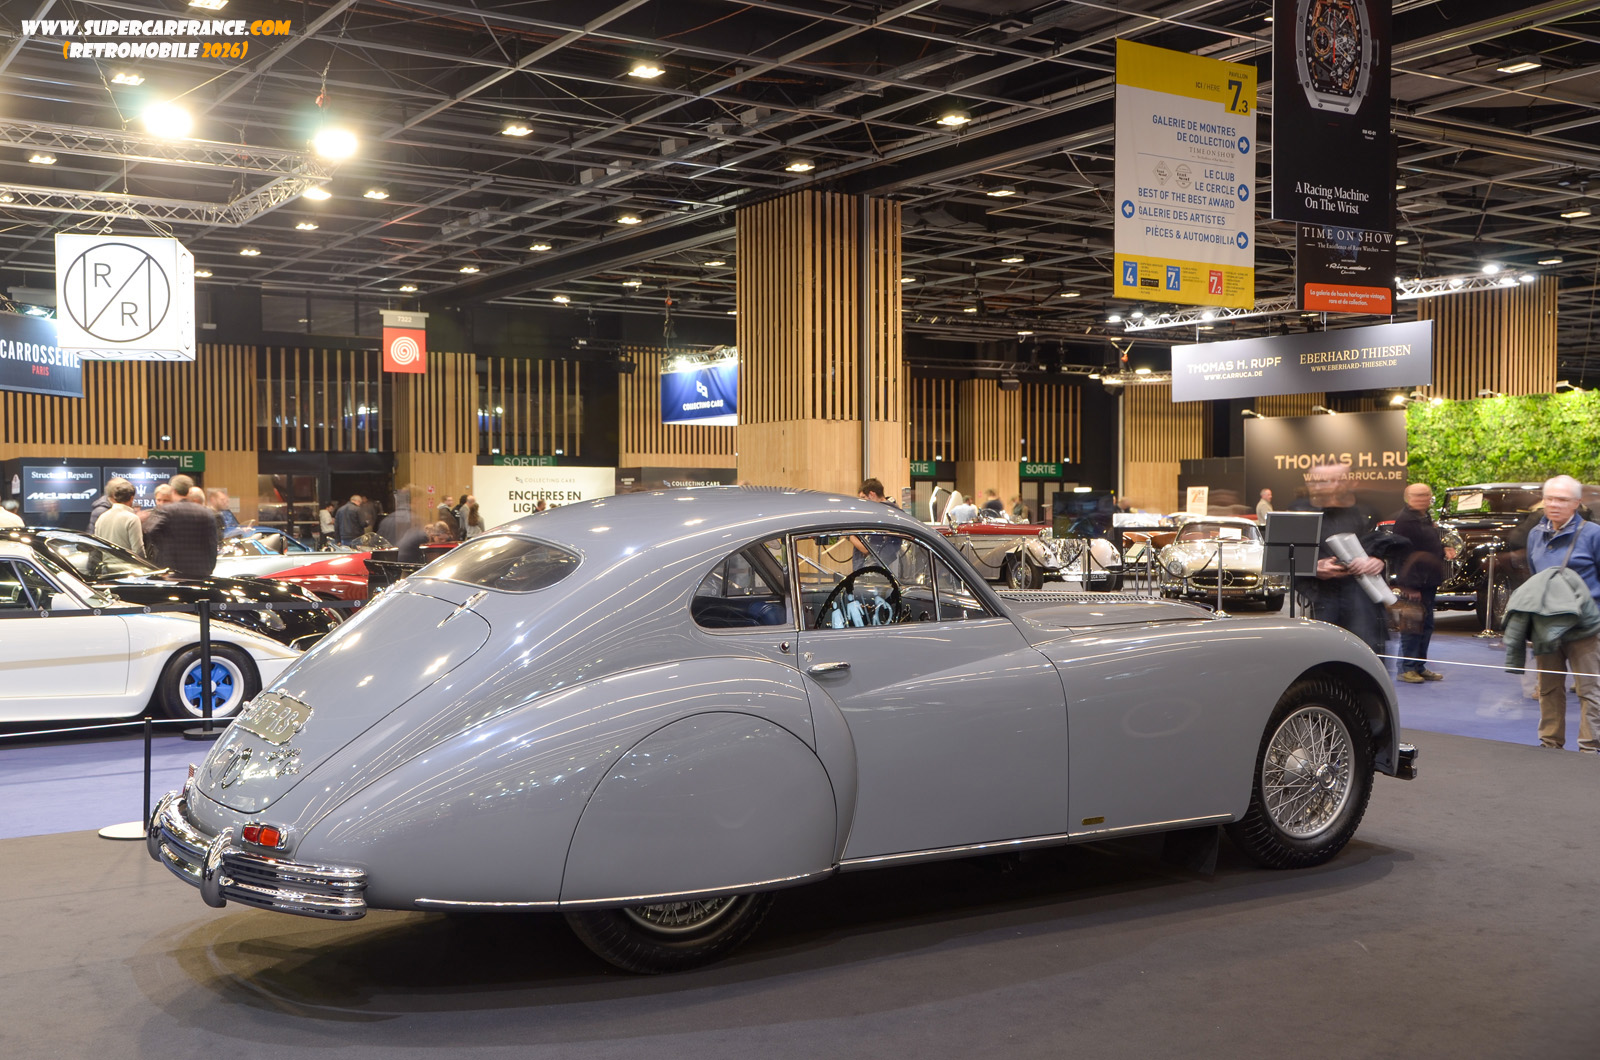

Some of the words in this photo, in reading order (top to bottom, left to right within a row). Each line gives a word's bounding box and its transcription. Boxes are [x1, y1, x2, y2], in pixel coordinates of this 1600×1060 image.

[1229, 71, 1248, 79] PAVILLON
[1206, 83, 1220, 92] HERE
[1228, 79, 1249, 113] 7.3
[1152, 115, 1185, 129] GALERIE
[1187, 120, 1198, 131] DE
[1200, 123, 1236, 137] MONTRES
[1177, 132, 1187, 142] DE
[1189, 133, 1236, 149] COLLECTION
[1204, 169, 1214, 179] LE
[1215, 170, 1235, 181] CLUB
[1195, 181, 1204, 191] LE
[1206, 183, 1235, 196] CERCLE
[1295, 181, 1302, 194] A
[1304, 182, 1333, 199] Racing
[1334, 186, 1369, 202] Machine
[1138, 187, 1158, 199] BEST
[1160, 190, 1169, 200] OF
[1171, 191, 1186, 203] THE
[1188, 194, 1207, 205] BEST
[1208, 197, 1235, 209] AWARD
[1305, 196, 1318, 209] On
[1320, 198, 1336, 211] The
[1337, 201, 1359, 215] Wrist
[1138, 206, 1170, 219] GALERIE
[1173, 210, 1188, 221] DES
[1190, 212, 1226, 226] ARTISTES
[1145, 224, 1174, 239] PIÈCES
[1175, 230, 1181, 239] &
[1183, 231, 1235, 245] AUTOMOBILIA
[1302, 226, 1333, 239] TIME
[1337, 229, 1354, 241] ON
[1358, 232, 1393, 244] SHOW
[1126, 267, 1134, 284] 4
[1167, 271, 1178, 289] 7.1
[1210, 276, 1222, 294] 7.2
[1316, 289, 1330, 297] galerie
[1349, 291, 1370, 299] horlogerie
[0, 338, 81, 369] CARROSSERIE
[1300, 349, 1359, 365] EBERHARD
[1361, 344, 1411, 360] THIESEN
[32, 364, 50, 376] PARIS
[1186, 360, 1234, 375] THOMAS
[1237, 358, 1249, 371] H.
[1250, 356, 1282, 369] RUPF
[1310, 359, 1397, 373] WWW.EBERHARD-THIESEN.DE
[1203, 370, 1263, 381] WWW.CARRUCA.DE
[503, 457, 548, 466] SORTIE
[910, 463, 929, 473] RTIE
[1274, 452, 1353, 470] THOMAS
[1358, 452, 1377, 467] H.
[1383, 451, 1408, 467] RU
[31, 471, 67, 480] Structural
[67, 472, 93, 481] Repairs
[145, 472, 170, 481] Repairs
[1025, 464, 1056, 475] SORTIE
[27, 491, 91, 501] McLaren
[509, 487, 565, 501] ENCHÈRES
[567, 491, 582, 501] EN
